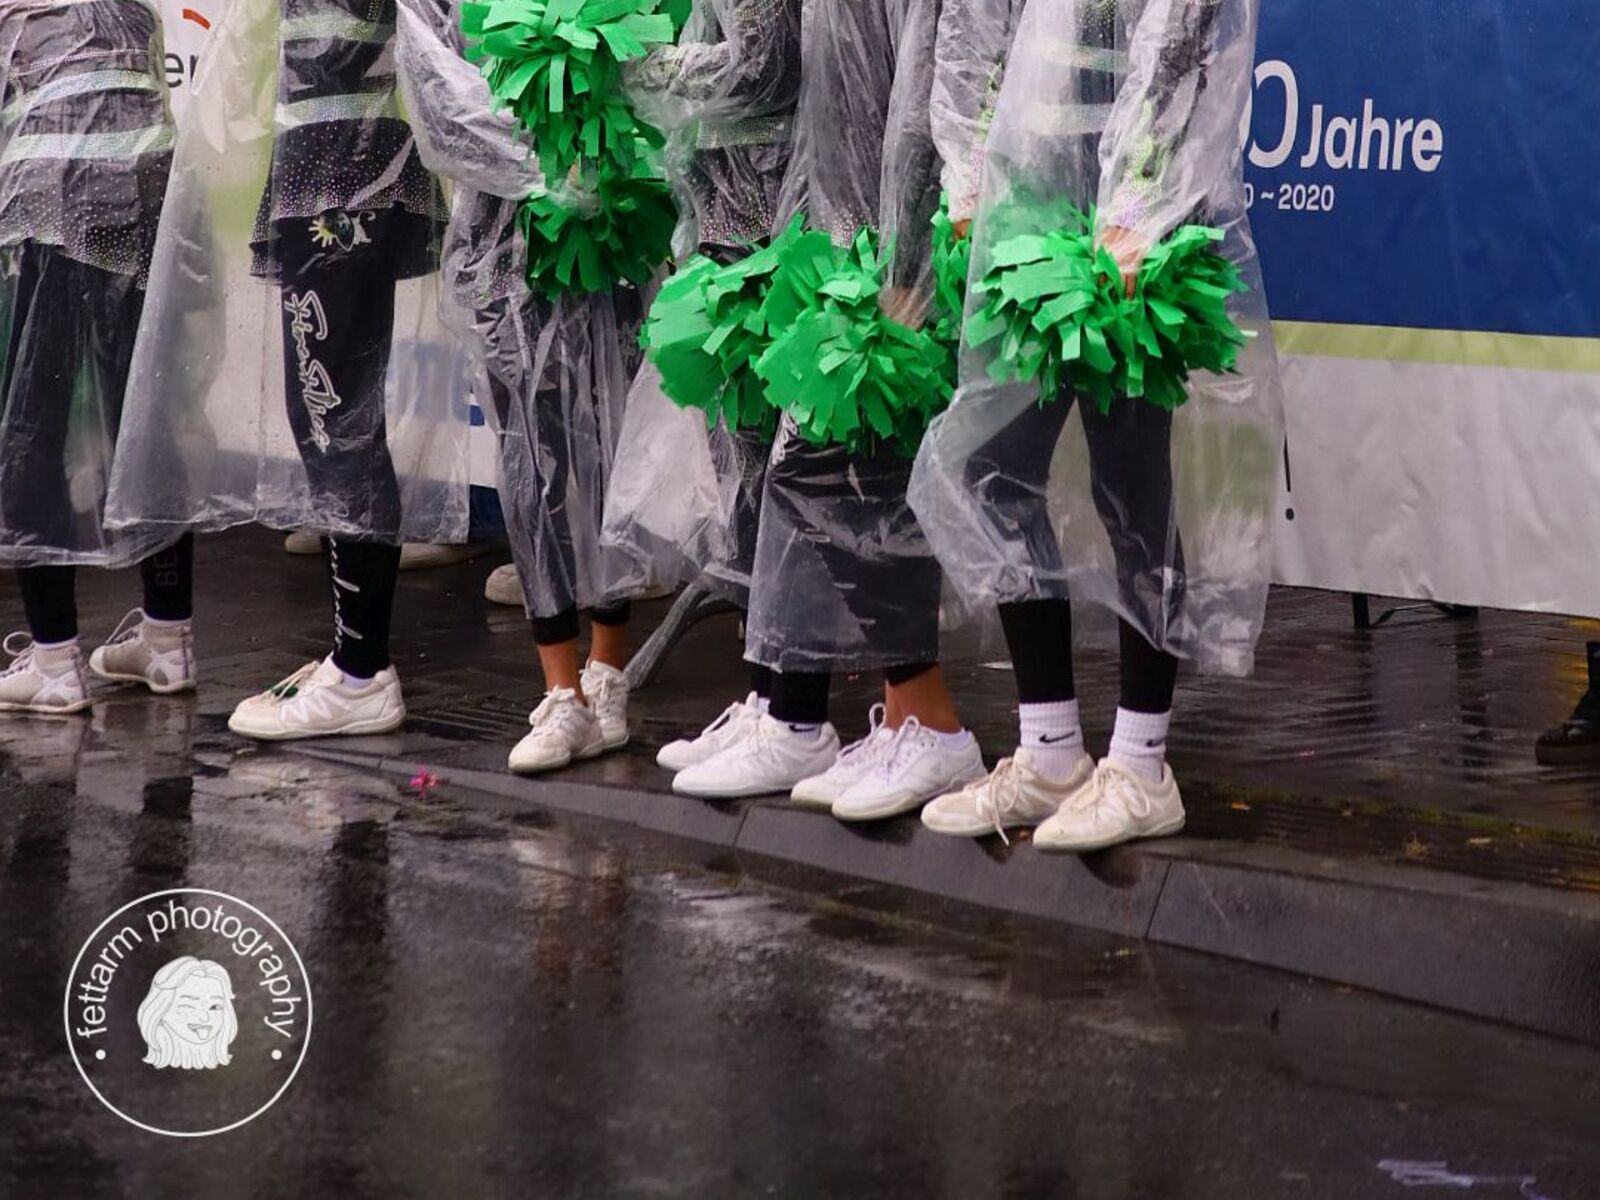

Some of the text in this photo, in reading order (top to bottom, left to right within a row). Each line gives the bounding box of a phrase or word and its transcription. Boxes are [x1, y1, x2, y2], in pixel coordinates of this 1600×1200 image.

[1239, 60, 1443, 172] 0 Jahre
[1278, 183, 1335, 211] 2020
